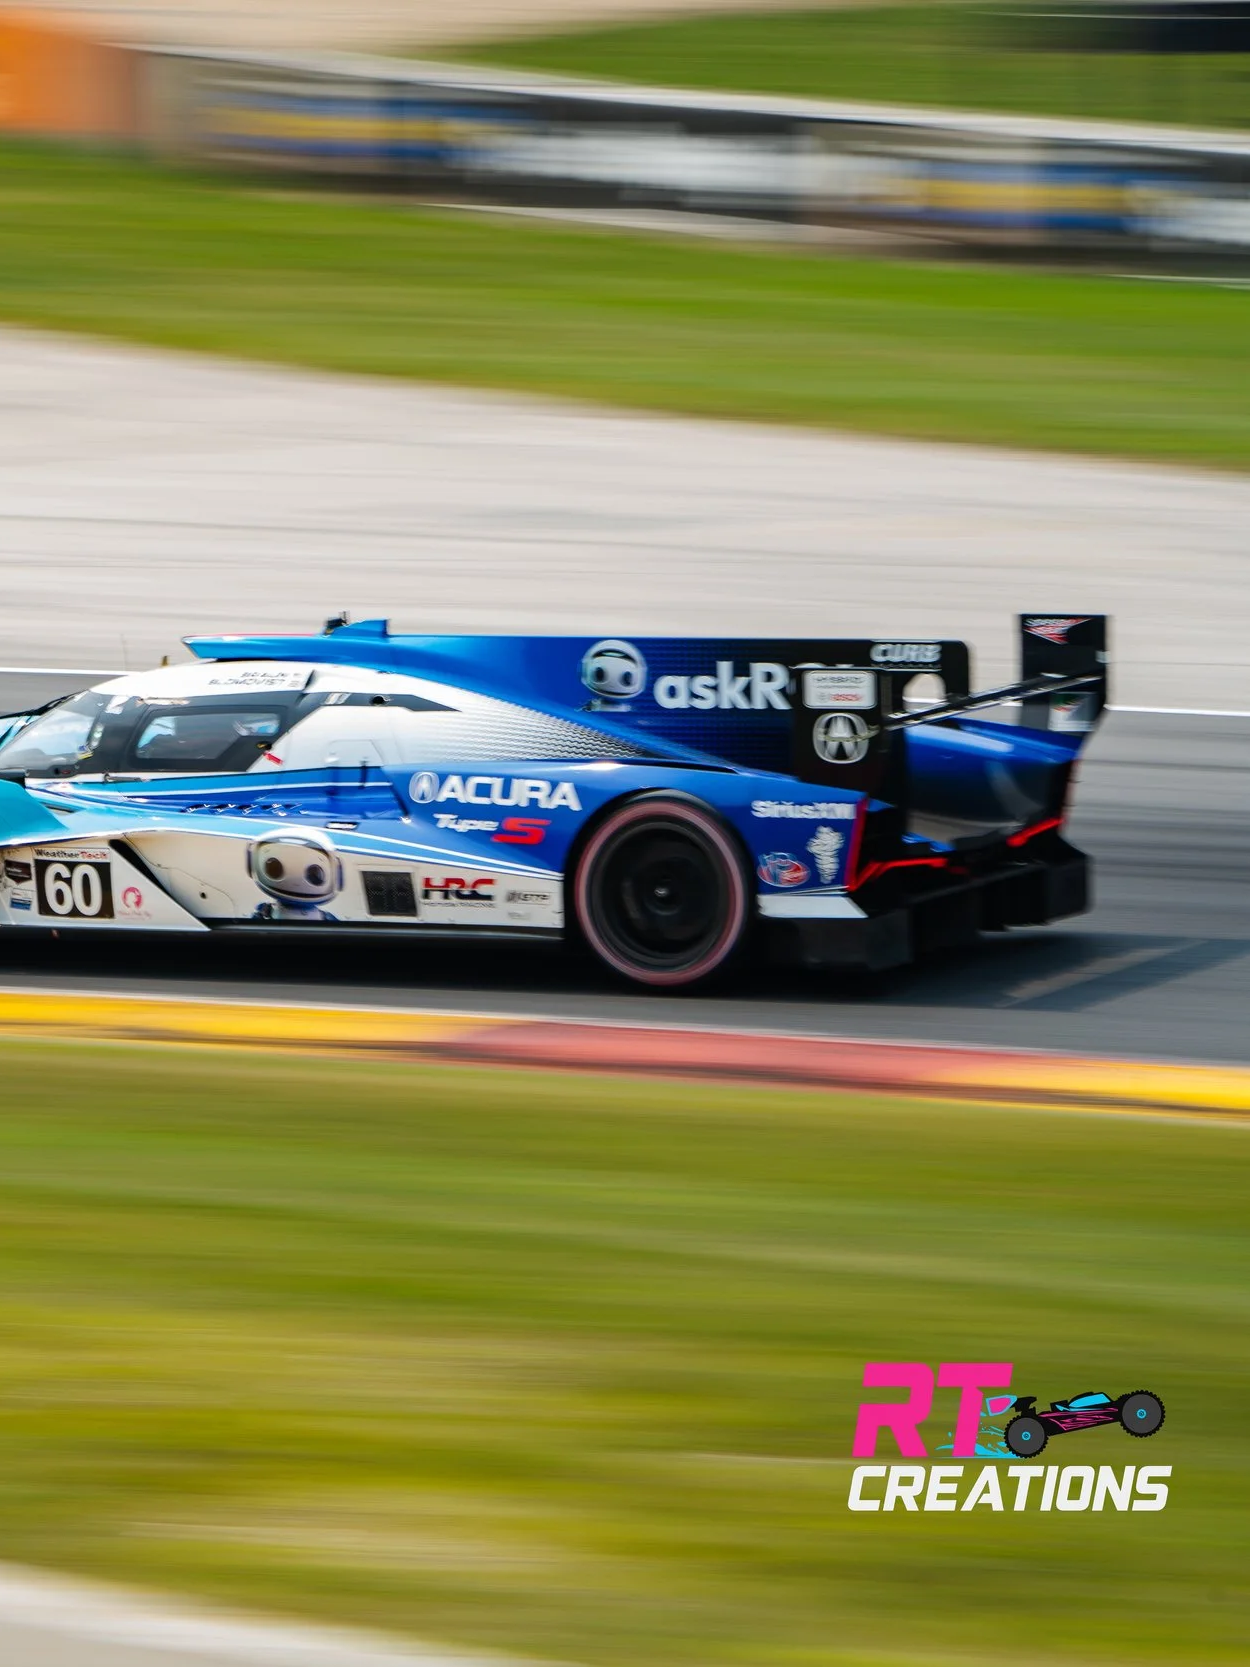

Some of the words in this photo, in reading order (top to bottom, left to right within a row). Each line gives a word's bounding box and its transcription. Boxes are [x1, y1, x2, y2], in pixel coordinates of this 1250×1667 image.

[871, 644, 942, 662] CURB
[653, 660, 854, 709] askR
[435, 775, 582, 811] ACURA
[433, 813, 499, 833] Type
[491, 817, 552, 845] S
[45, 862, 103, 917] 60
[422, 877, 496, 901] HRC
